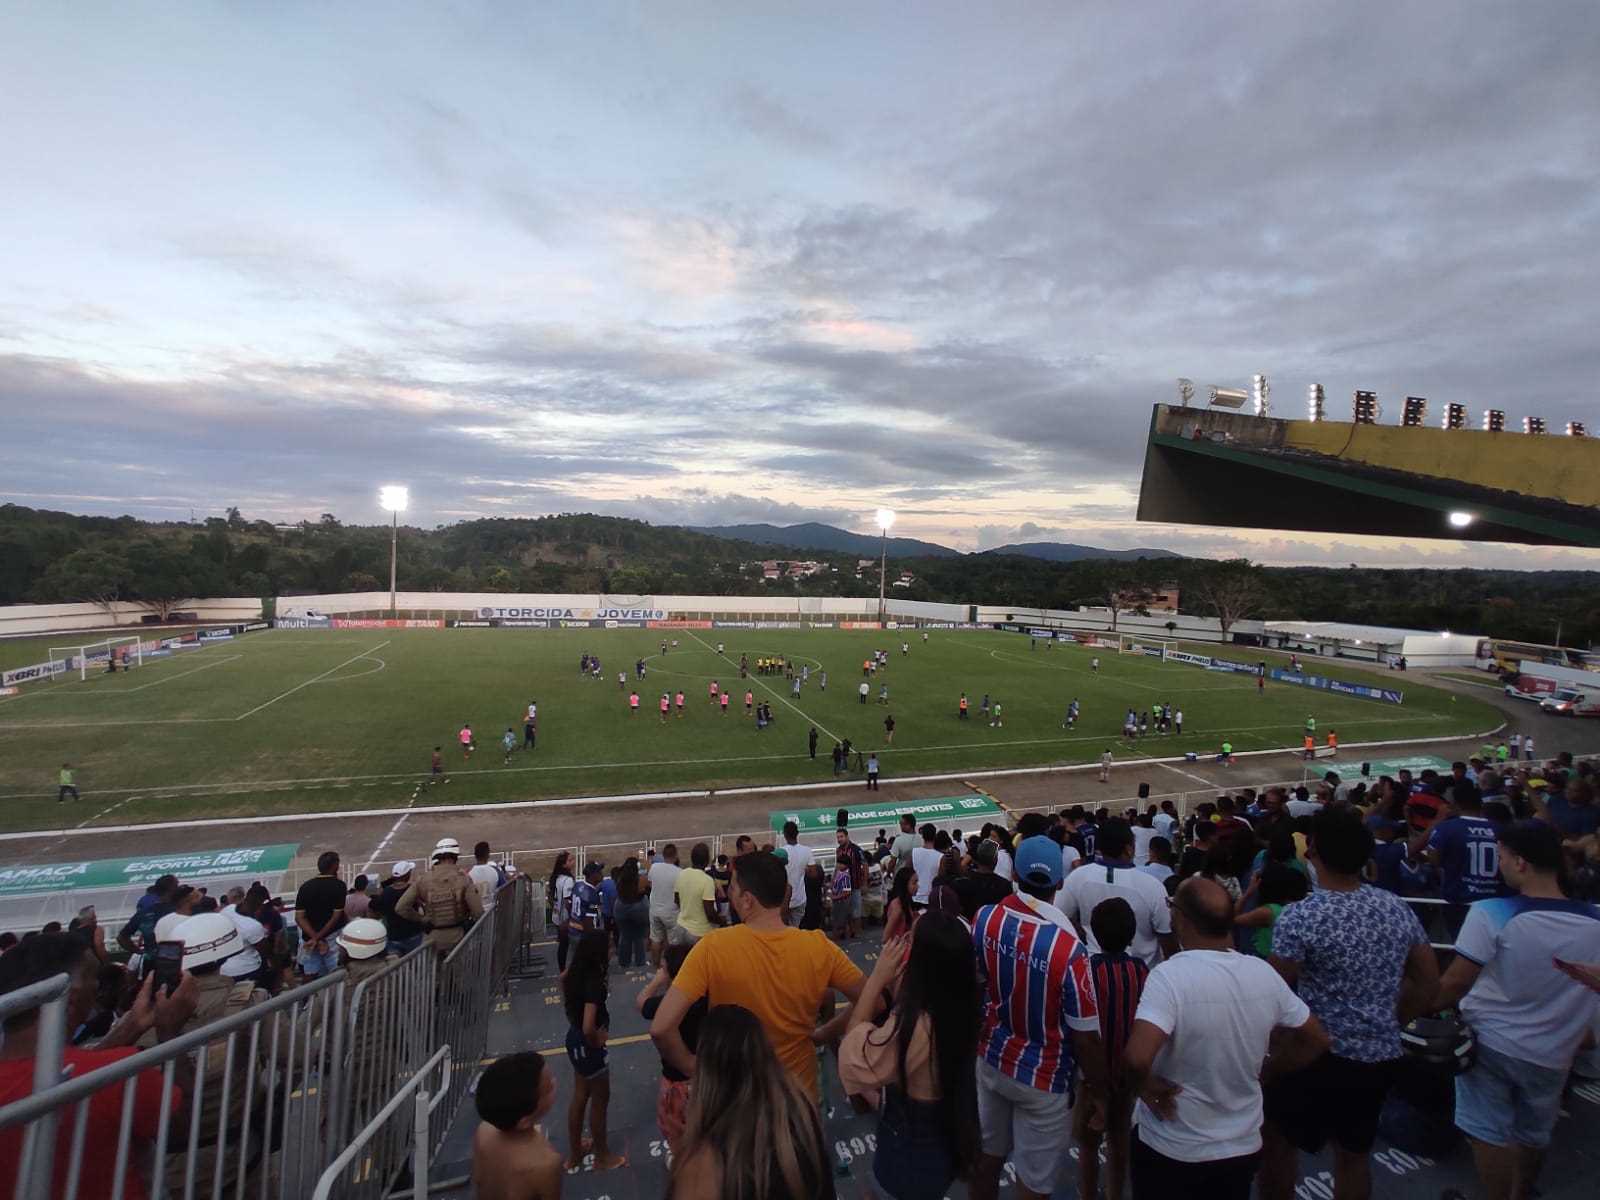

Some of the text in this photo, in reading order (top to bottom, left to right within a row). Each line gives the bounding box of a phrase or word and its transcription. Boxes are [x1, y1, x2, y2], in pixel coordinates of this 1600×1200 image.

[496, 608, 652, 619] TORCIDA JOVEM
[278, 619, 309, 629] Multi
[896, 803, 954, 815] ESPORTES
[1466, 841, 1499, 877] 10
